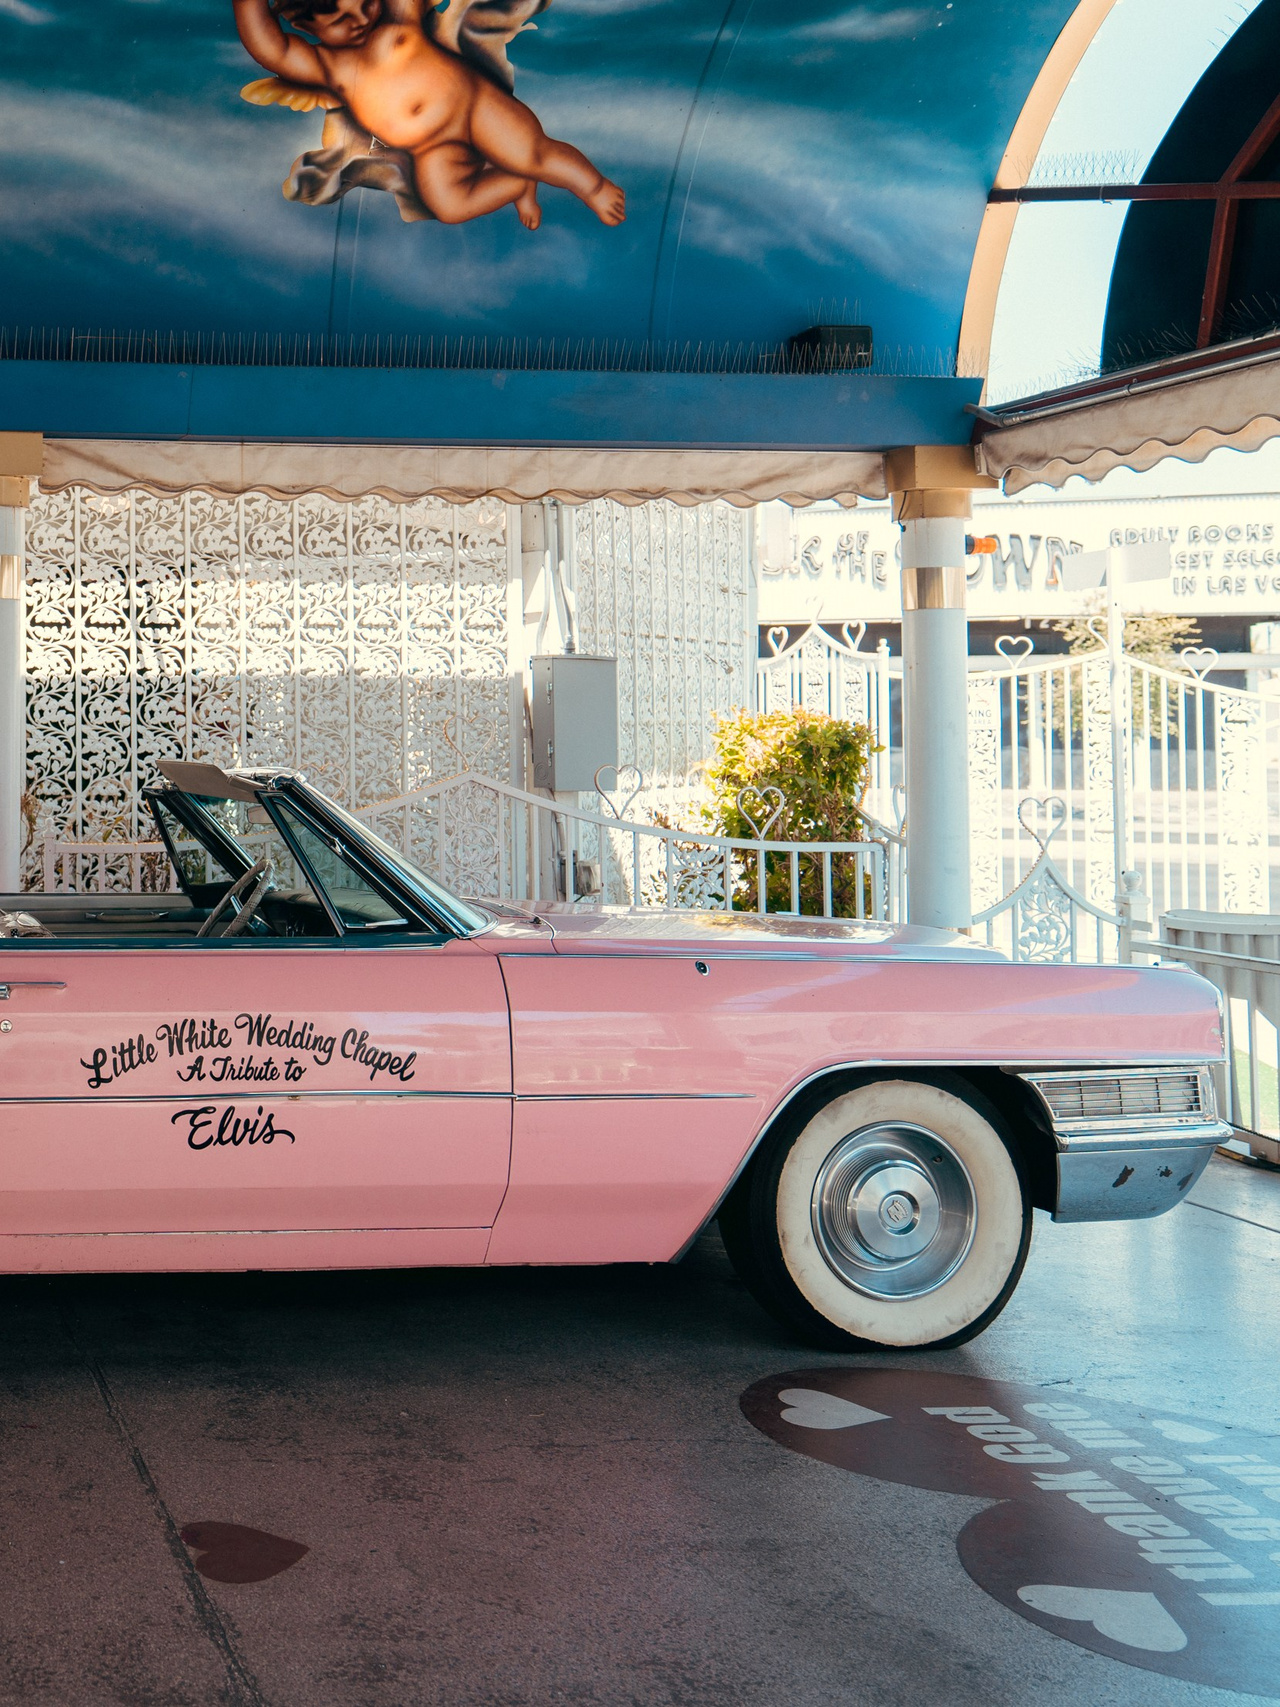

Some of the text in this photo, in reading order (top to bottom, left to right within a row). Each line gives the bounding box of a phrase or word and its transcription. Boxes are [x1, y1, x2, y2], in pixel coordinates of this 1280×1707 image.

[837, 531, 869, 552] OF
[1109, 524, 1273, 547] ADULT BOOKS
[833, 550, 887, 587] THE
[1222, 549, 1280, 569] SELE
[1172, 576, 1196, 595] IN
[1206, 575, 1246, 595] LAS
[80, 1013, 417, 1089] Little White Wedding Chapel
[176, 1056, 307, 1082] A Tribute to
[170, 1105, 296, 1150] Elvis
[921, 1406, 1071, 1463] God
[1022, 1402, 1147, 1448] me
[1030, 1470, 1255, 1582] thank
